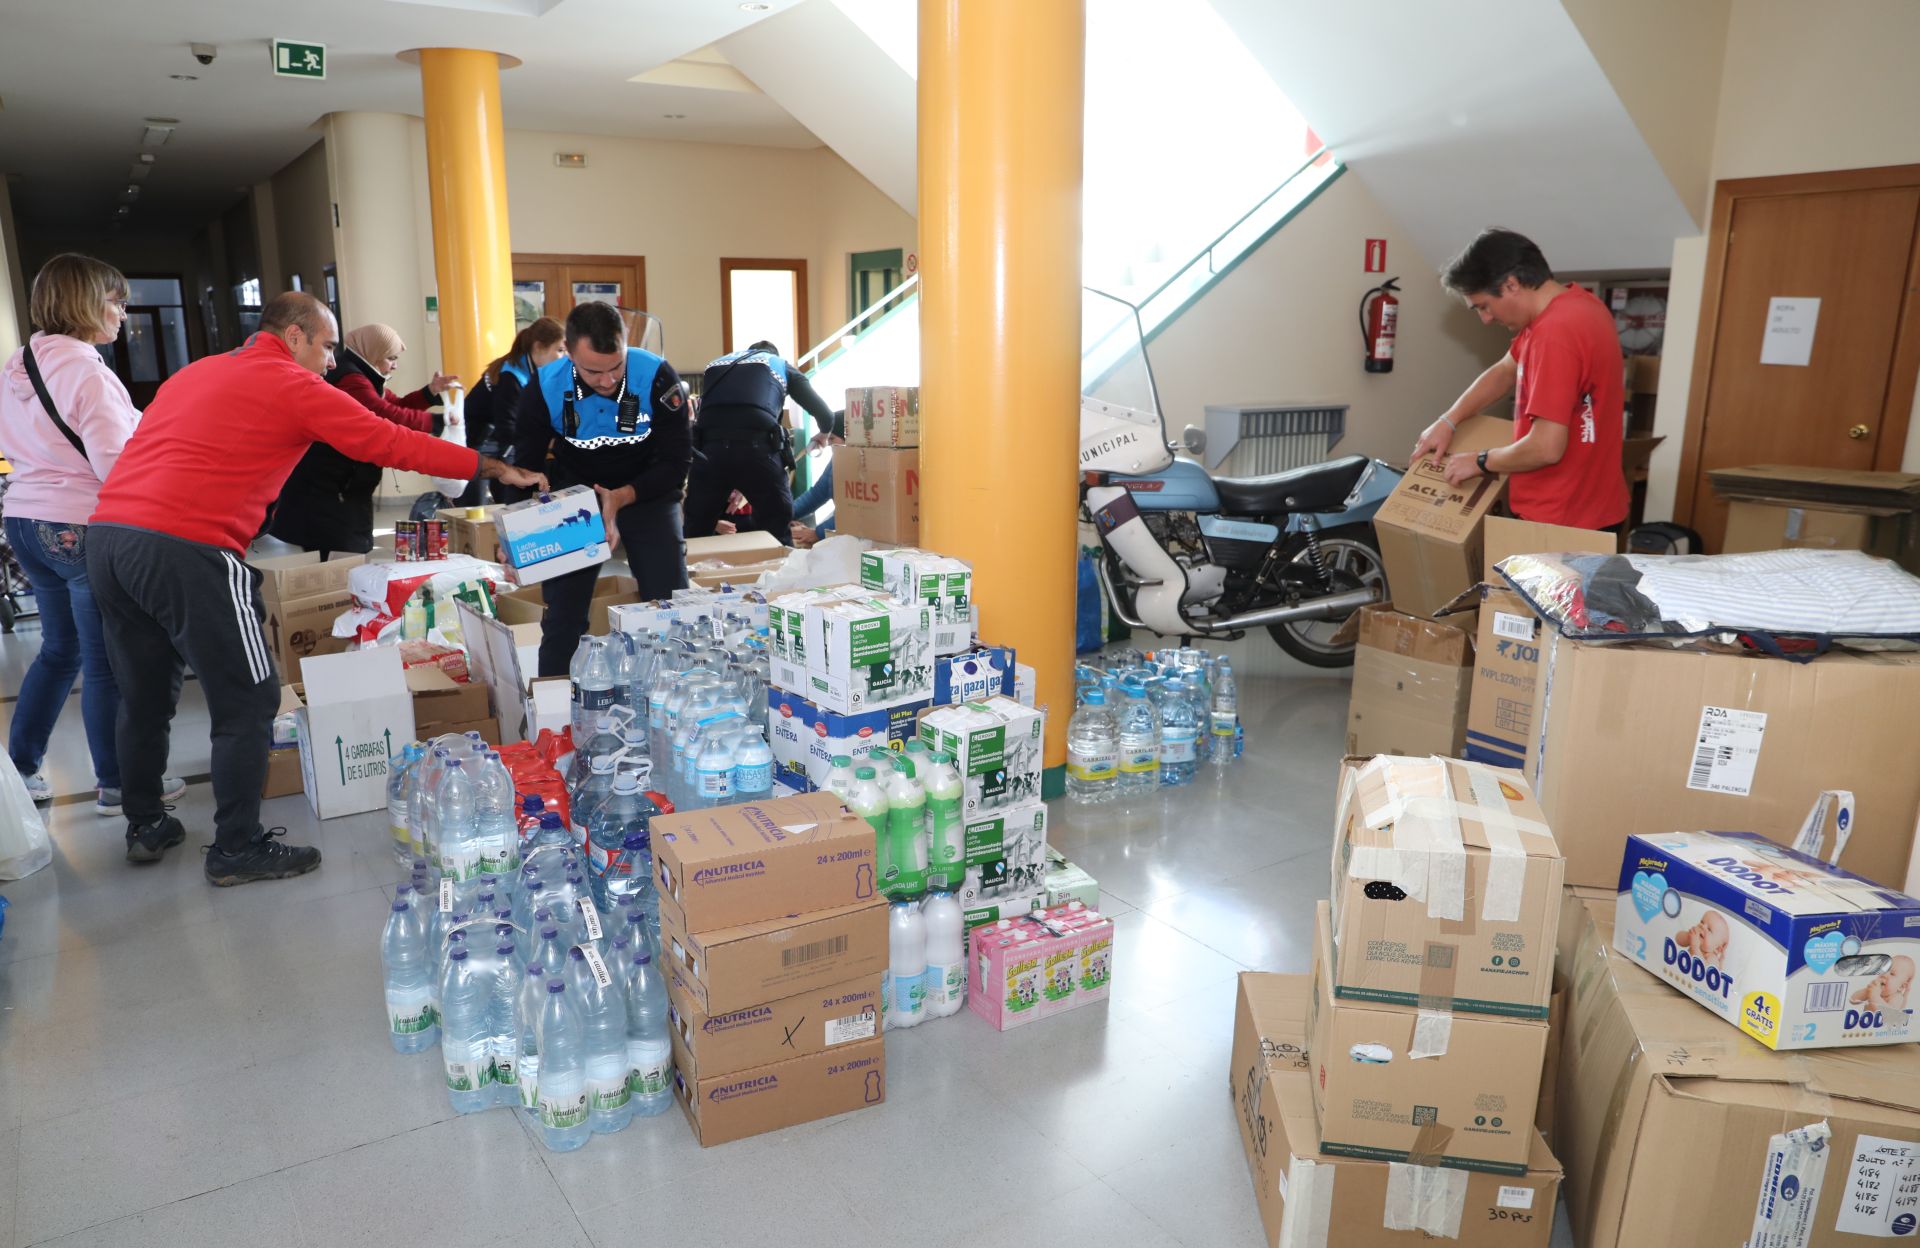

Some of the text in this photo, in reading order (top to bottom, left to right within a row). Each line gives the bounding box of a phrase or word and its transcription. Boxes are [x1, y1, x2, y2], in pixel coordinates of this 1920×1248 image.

[851, 400, 885, 418] NLS
[845, 480, 880, 502] NELS
[519, 542, 562, 563] ENTERA
[872, 679, 892, 687] GALICIA
[964, 679, 985, 696] gaza
[1706, 708, 1727, 718] RDA
[775, 726, 797, 742] ENTERA
[345, 741, 385, 760] 4 GARRAFAS
[810, 745, 832, 762] ENTERA
[347, 761, 387, 780] DE 5 LITROS
[985, 786, 1004, 794] GALICIA
[751, 808, 786, 842] NUTRICIA
[817, 855, 829, 865] 24
[837, 849, 863, 861] 200ml
[704, 860, 765, 878] NUTRICIA
[1706, 856, 1794, 896] DODOT
[984, 877, 1005, 885] GALICIA
[968, 912, 989, 921] EROSKI
[1636, 936, 1647, 960] 2
[1663, 937, 1734, 998] DODOT
[823, 998, 833, 1008] 24
[842, 992, 867, 1004] 200ml
[714, 1007, 773, 1026] NUTRICIA
[1746, 1008, 1774, 1030] GRATIS
[1803, 1023, 1817, 1041] 2
[828, 1065, 838, 1075] 24
[847, 1059, 872, 1071] 200ml
[720, 1075, 778, 1094] NUTRICIA
[1857, 1154, 1886, 1165] BULTO
[1907, 1158, 1915, 1168] 7
[1858, 1166, 1881, 1178] 4184
[1857, 1179, 1881, 1190] 4182
[1855, 1191, 1880, 1202] 4185
[1487, 1208, 1508, 1220] 30
[1854, 1203, 1879, 1216] 4186
